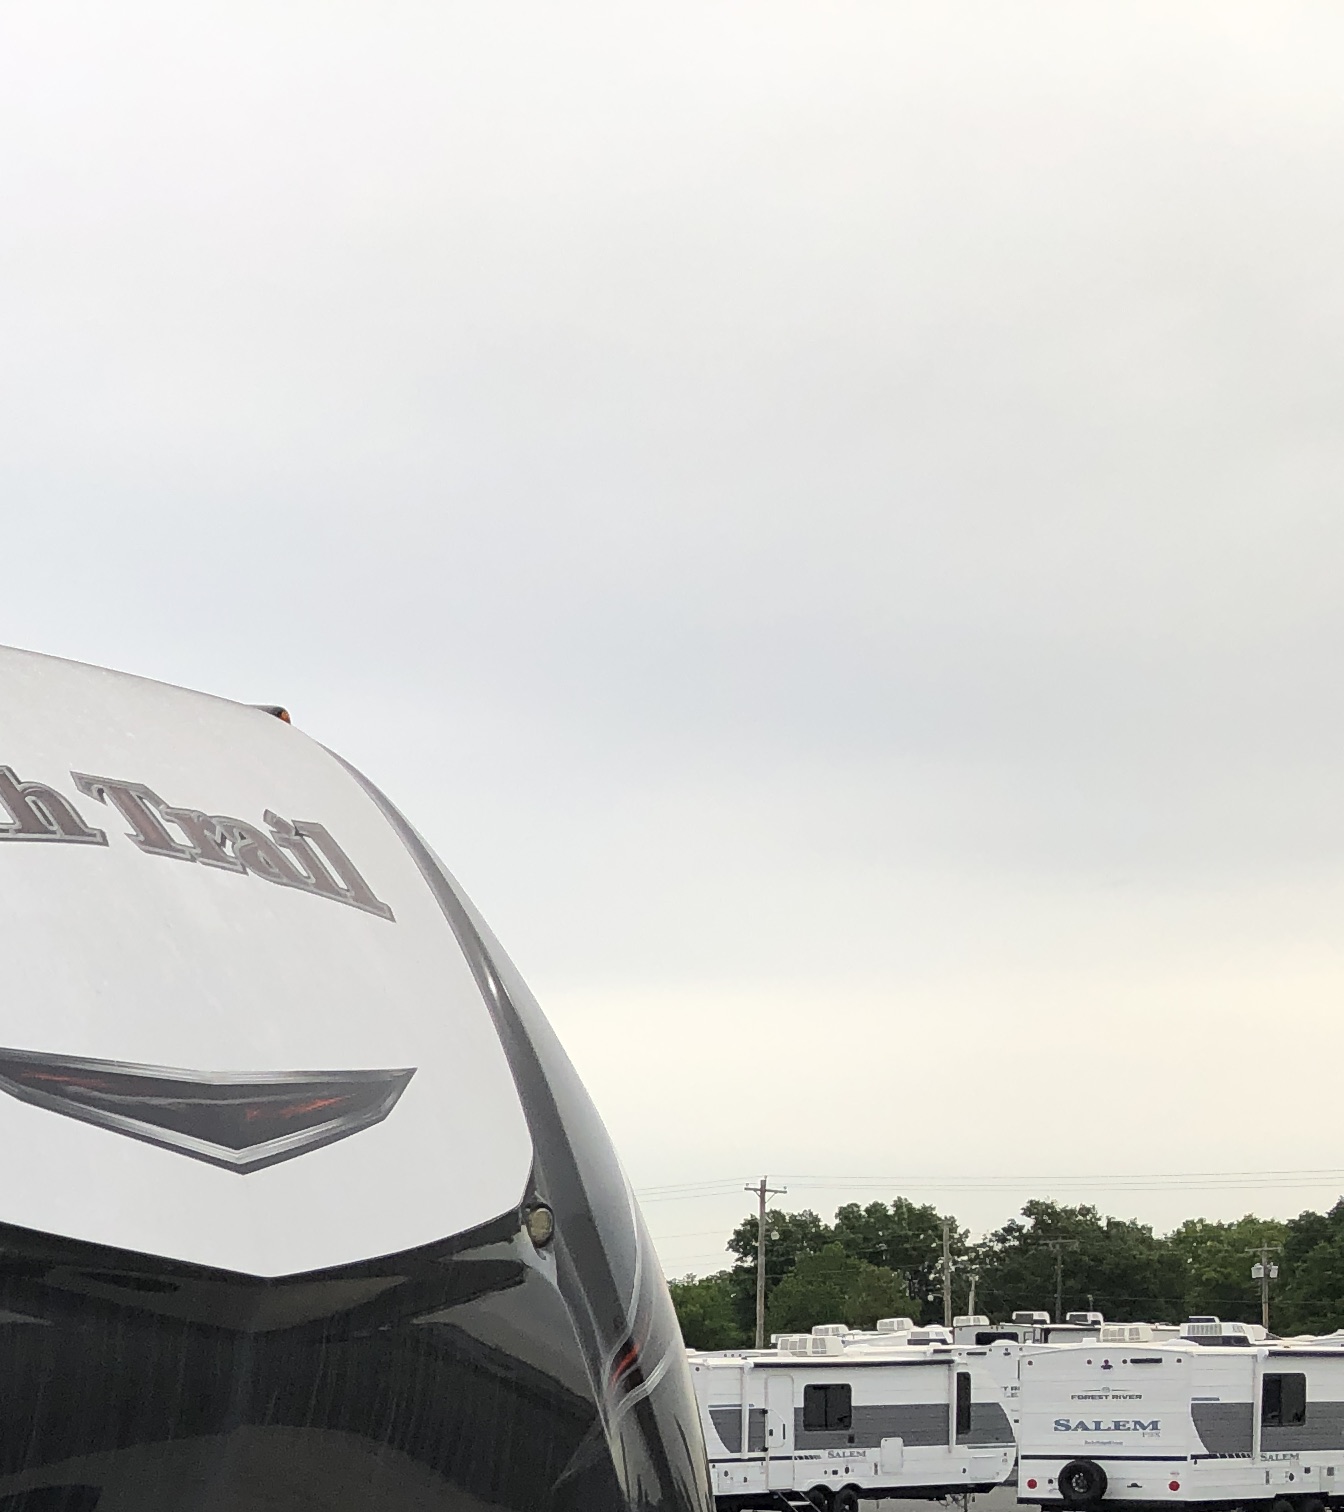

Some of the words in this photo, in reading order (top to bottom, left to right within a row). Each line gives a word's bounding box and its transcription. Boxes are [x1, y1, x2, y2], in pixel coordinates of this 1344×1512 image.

[70, 769, 396, 924] Trail
[1053, 1418, 1161, 1432] SALEM
[827, 1449, 866, 1459] SALEM
[1260, 1452, 1300, 1462] SALEM
